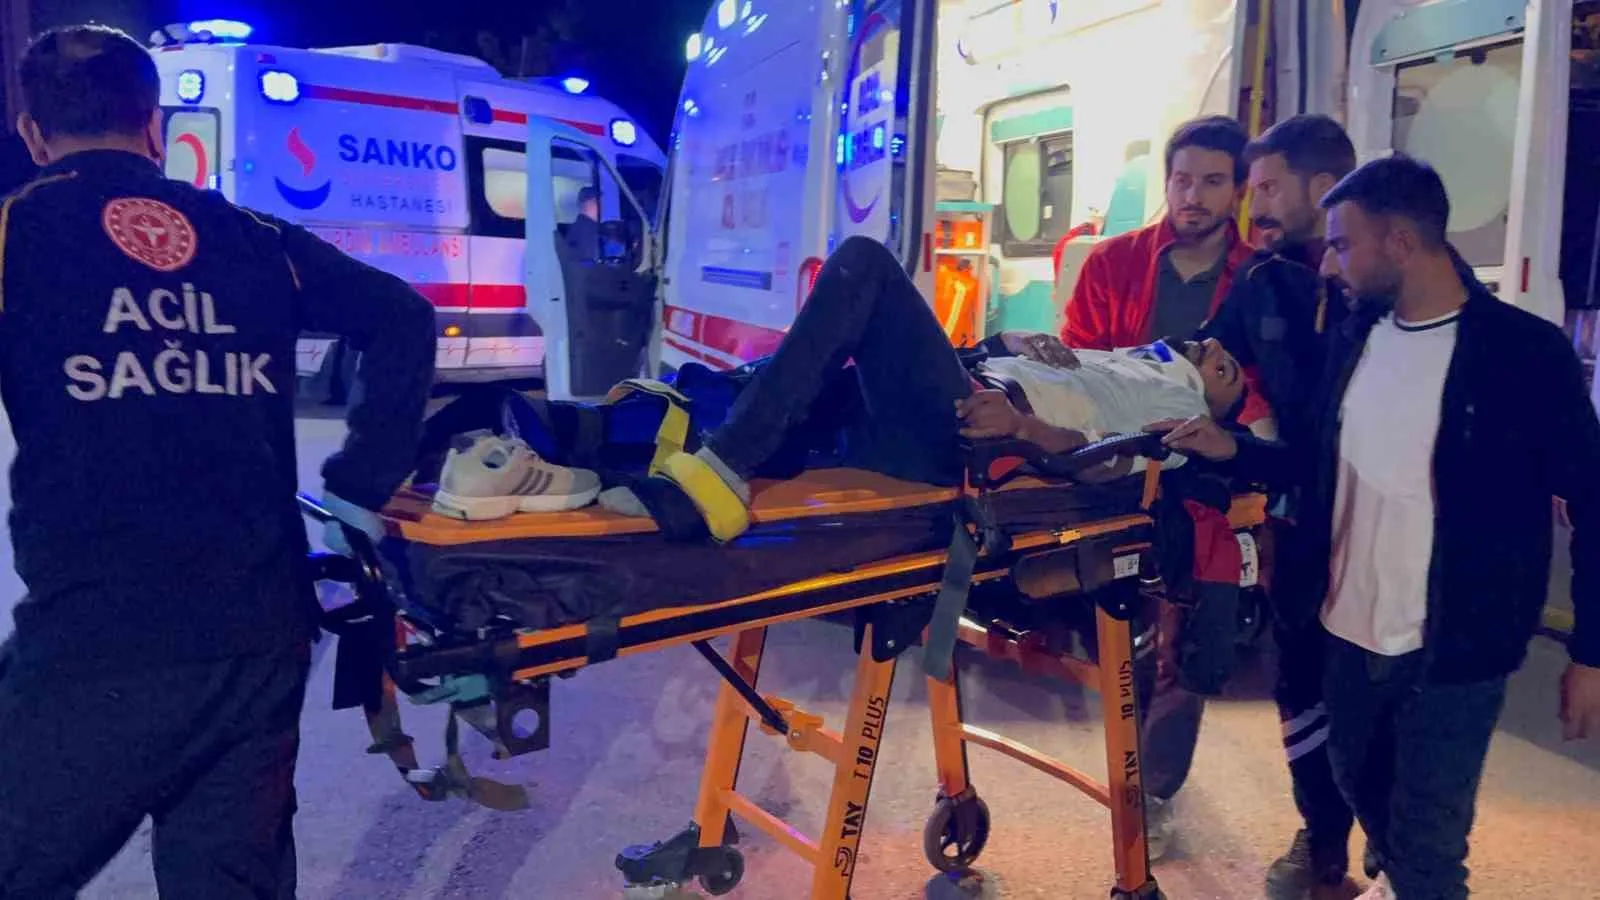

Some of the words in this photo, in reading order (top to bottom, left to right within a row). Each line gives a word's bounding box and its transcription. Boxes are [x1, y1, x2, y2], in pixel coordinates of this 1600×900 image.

[338, 133, 457, 172] SANKO
[103, 282, 237, 334] ACİL
[63, 337, 278, 401] SAĞLIK
[862, 695, 885, 740] PLUS
[856, 746, 874, 767] 10
[841, 800, 863, 839] TAY
